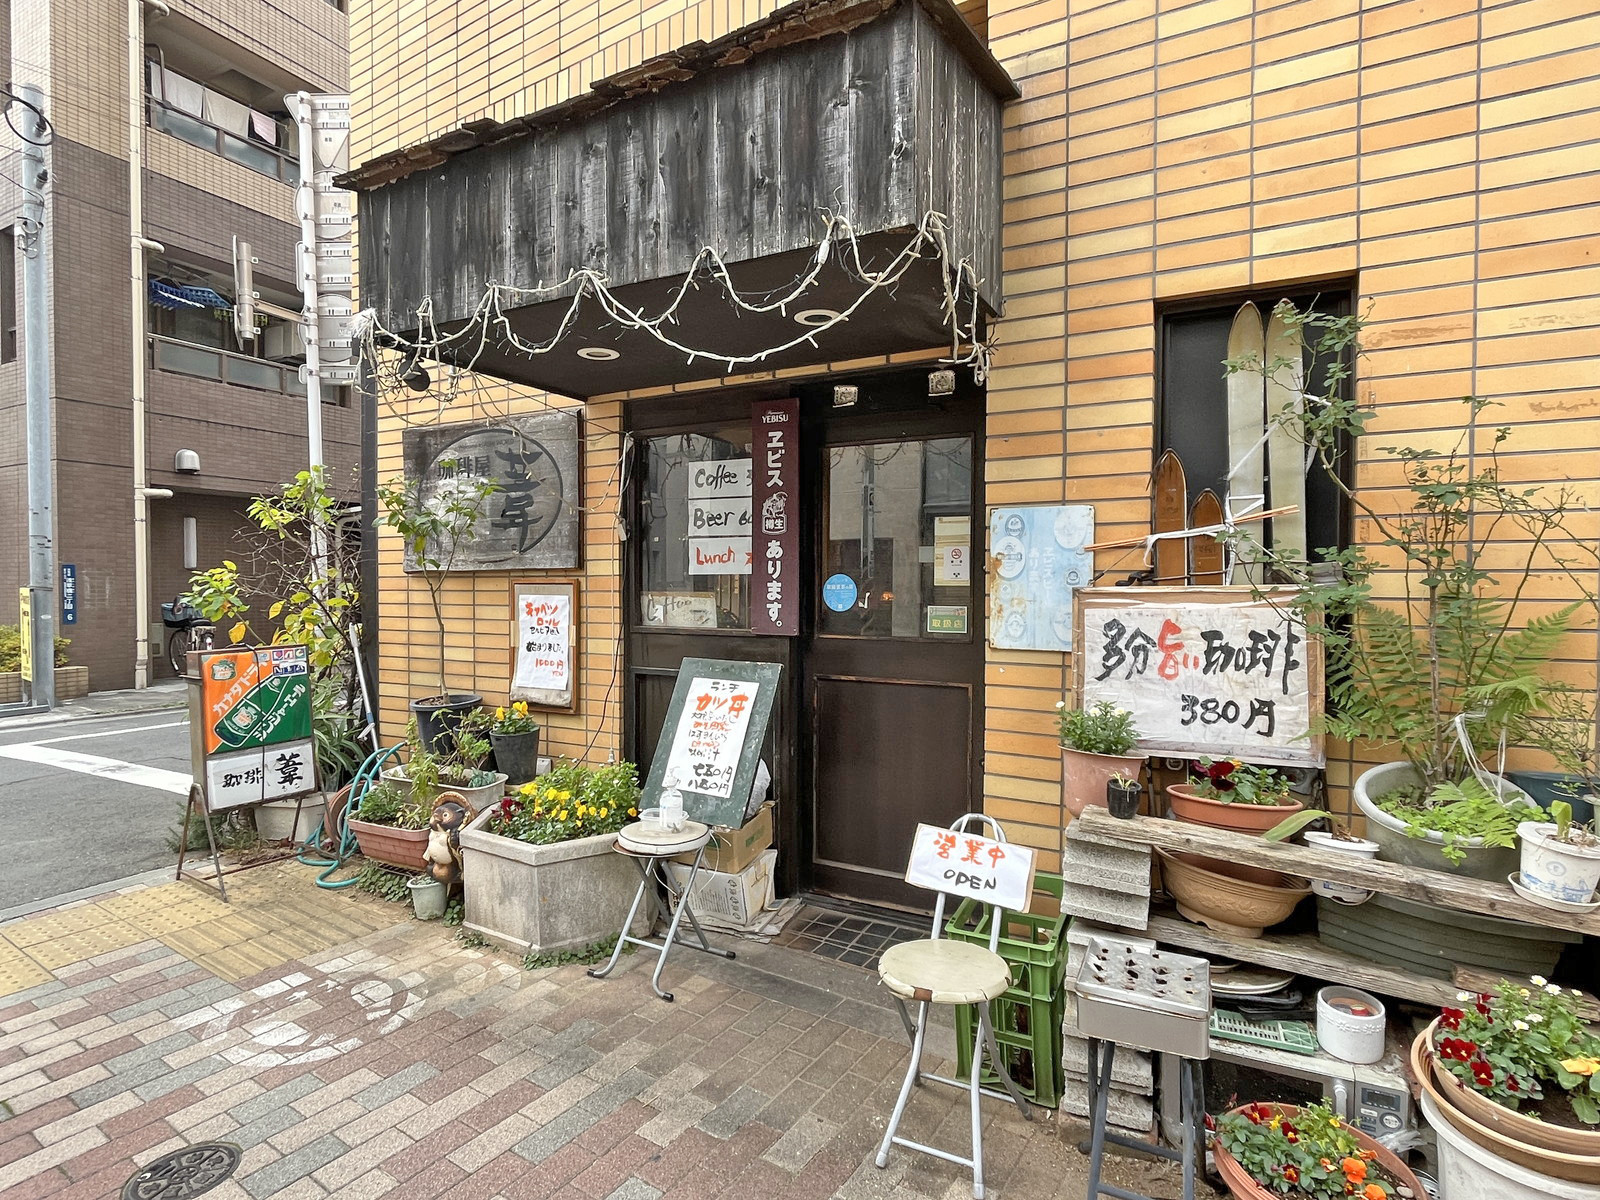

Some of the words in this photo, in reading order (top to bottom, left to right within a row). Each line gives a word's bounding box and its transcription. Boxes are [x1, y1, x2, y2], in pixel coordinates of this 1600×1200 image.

[762, 415, 789, 424] YEBISU
[694, 464, 739, 490] Coffee
[693, 508, 735, 529] Beer
[696, 546, 736, 566] Lunch
[765, 539, 783, 628] あります。
[932, 618, 963, 629] 取扱店
[711, 681, 740, 693] ランチ
[253, 683, 307, 742] ジンジャーエール
[696, 693, 749, 718] カツ丼
[1180, 693, 1276, 738] 380円
[223, 767, 263, 788] 珈琲
[933, 832, 1006, 868] 営業中
[943, 869, 997, 890] OPEN
